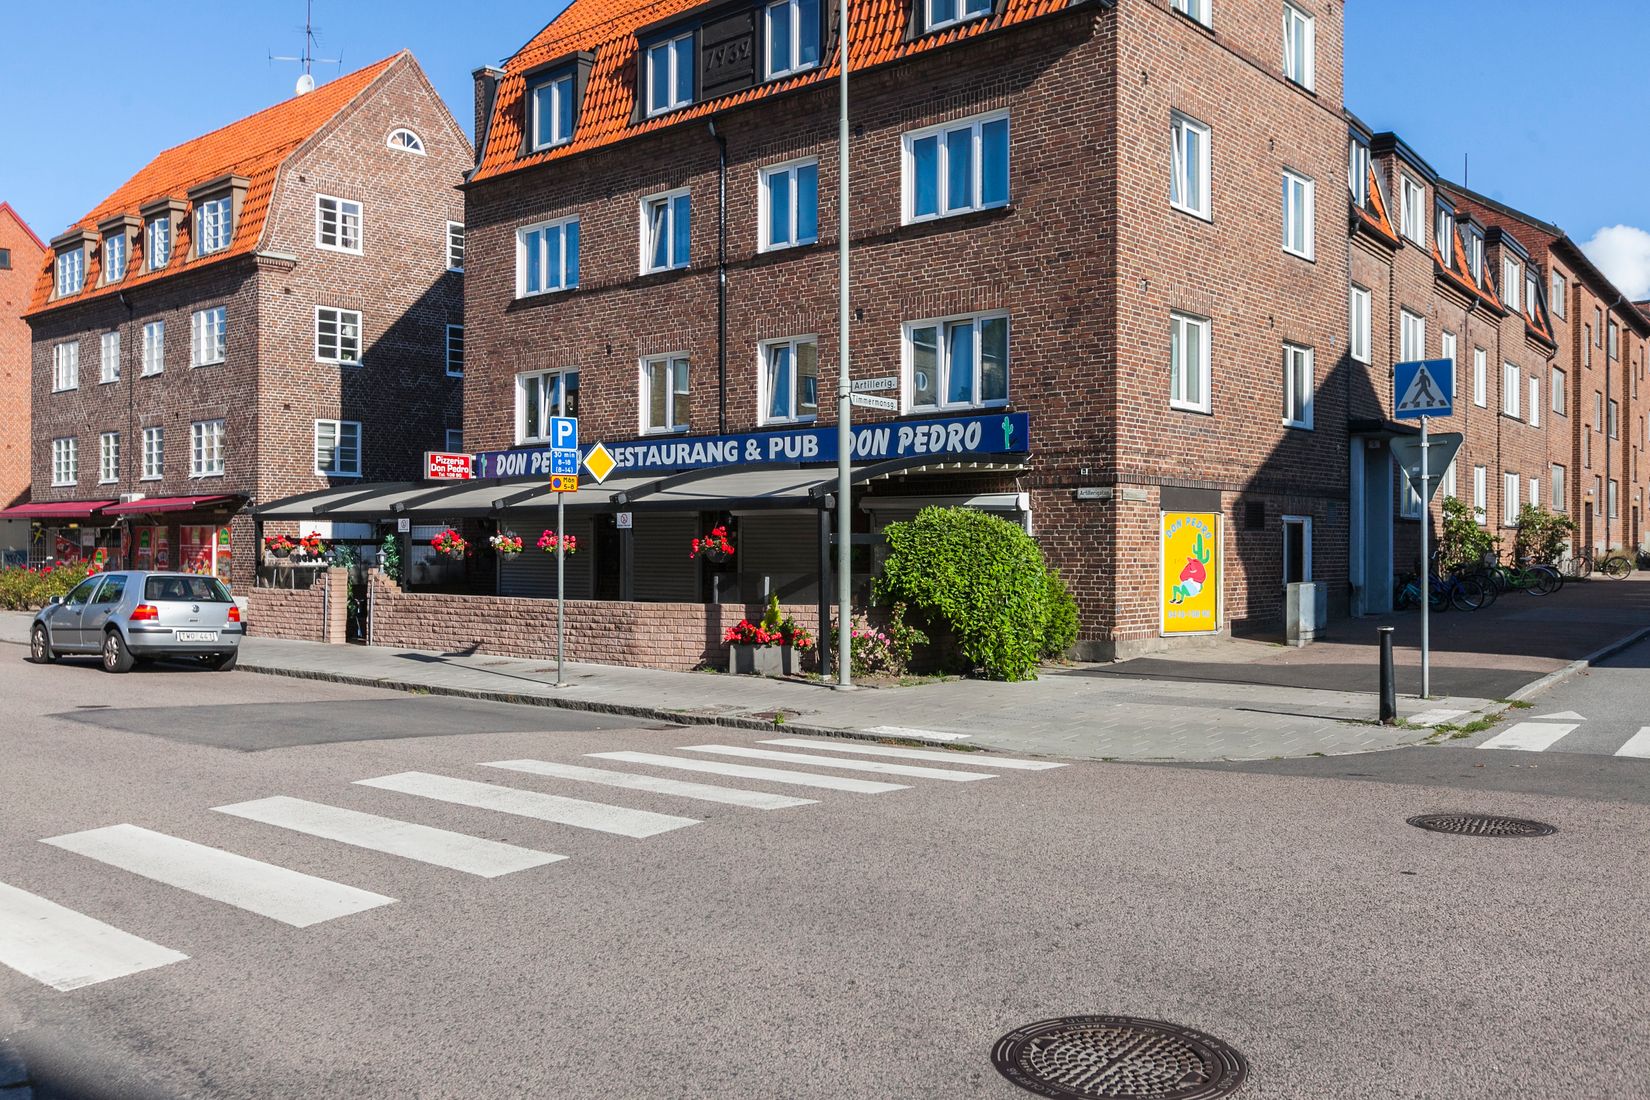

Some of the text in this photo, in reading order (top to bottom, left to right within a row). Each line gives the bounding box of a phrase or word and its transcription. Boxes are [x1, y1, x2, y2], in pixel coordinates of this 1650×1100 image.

[854, 379, 895, 390] Artillerig.
[557, 420, 573, 447] P
[496, 453, 528, 476] DON
[745, 438, 762, 461] &
[769, 434, 818, 459] PUB
[897, 421, 982, 455] PEDRO
[435, 455, 465, 466] Pizzeria
[431, 463, 469, 473] Don Pedro
[1079, 489, 1110, 498] Artillerigatan
[1166, 516, 1212, 540] DON PEDRO
